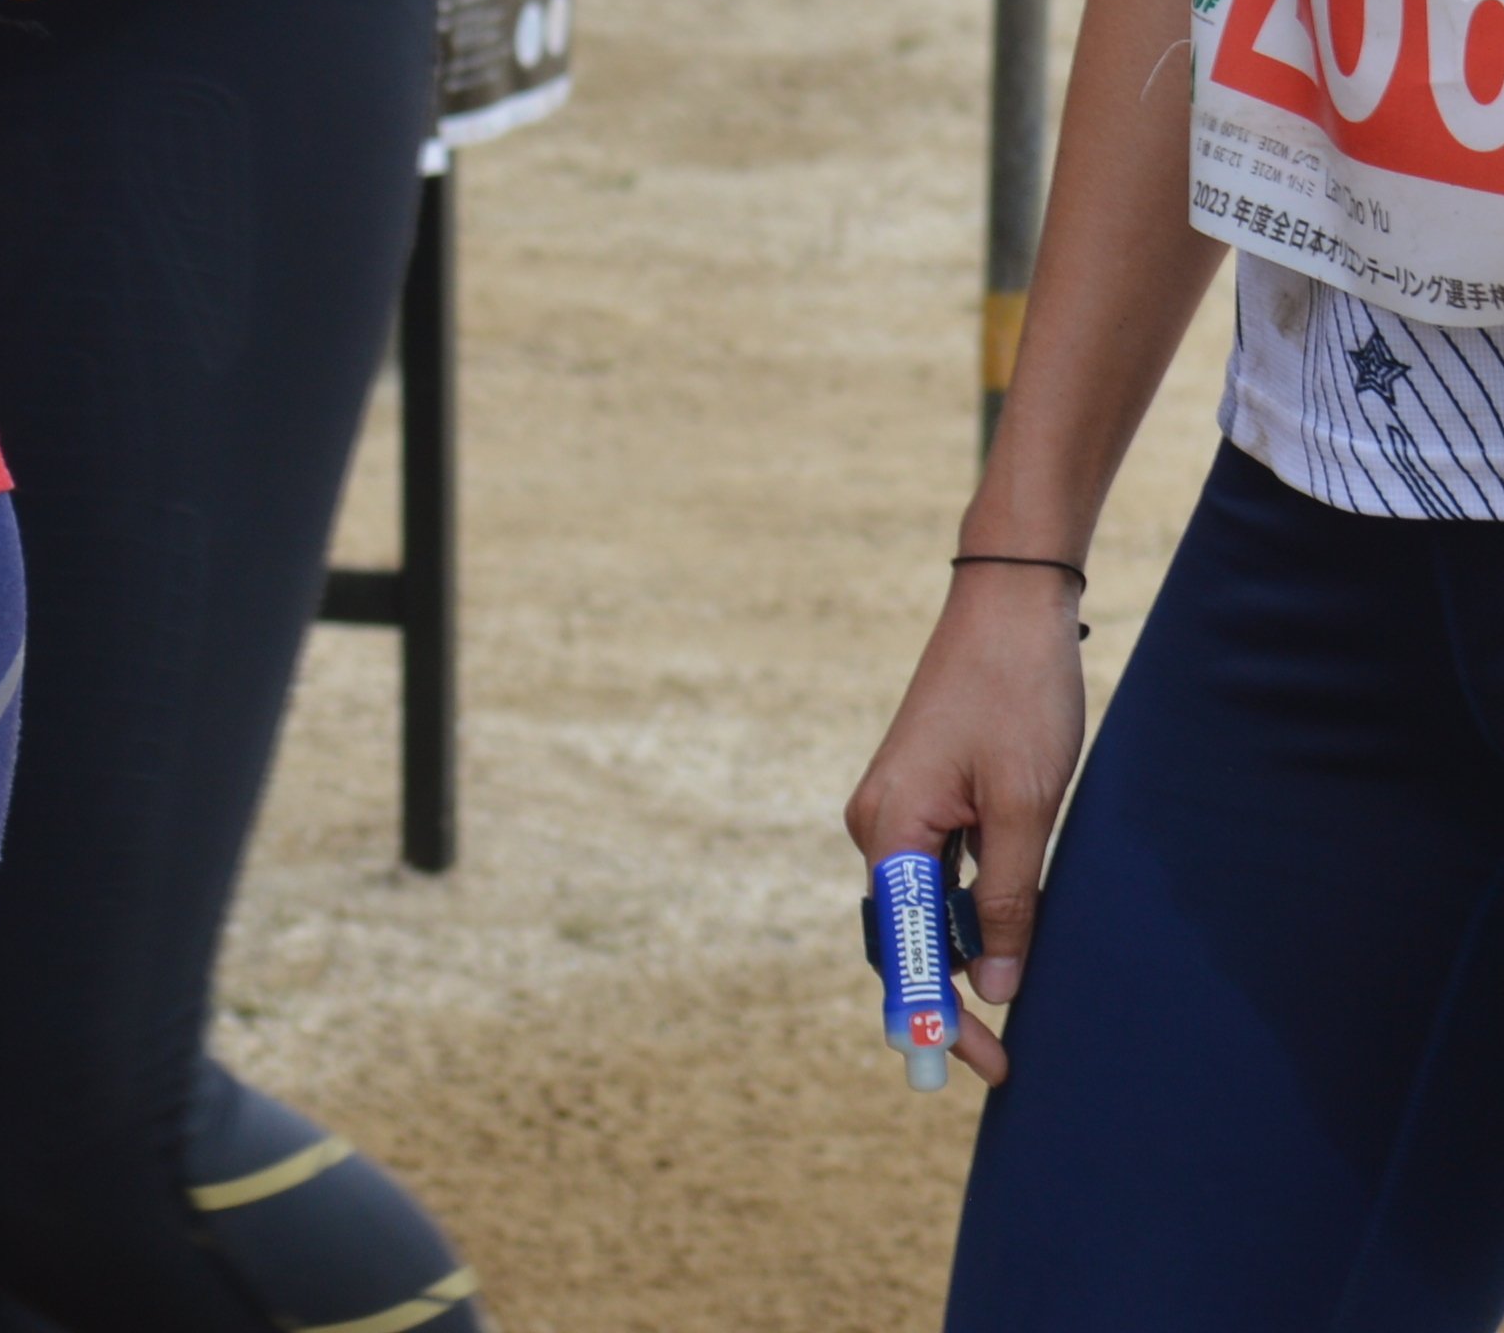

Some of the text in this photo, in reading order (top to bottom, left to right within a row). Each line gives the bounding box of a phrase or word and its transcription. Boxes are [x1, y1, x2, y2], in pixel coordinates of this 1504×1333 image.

[1192, 180, 1231, 219] 2023
[1368, 197, 1391, 234] Yu
[908, 908, 924, 977] 8361119
